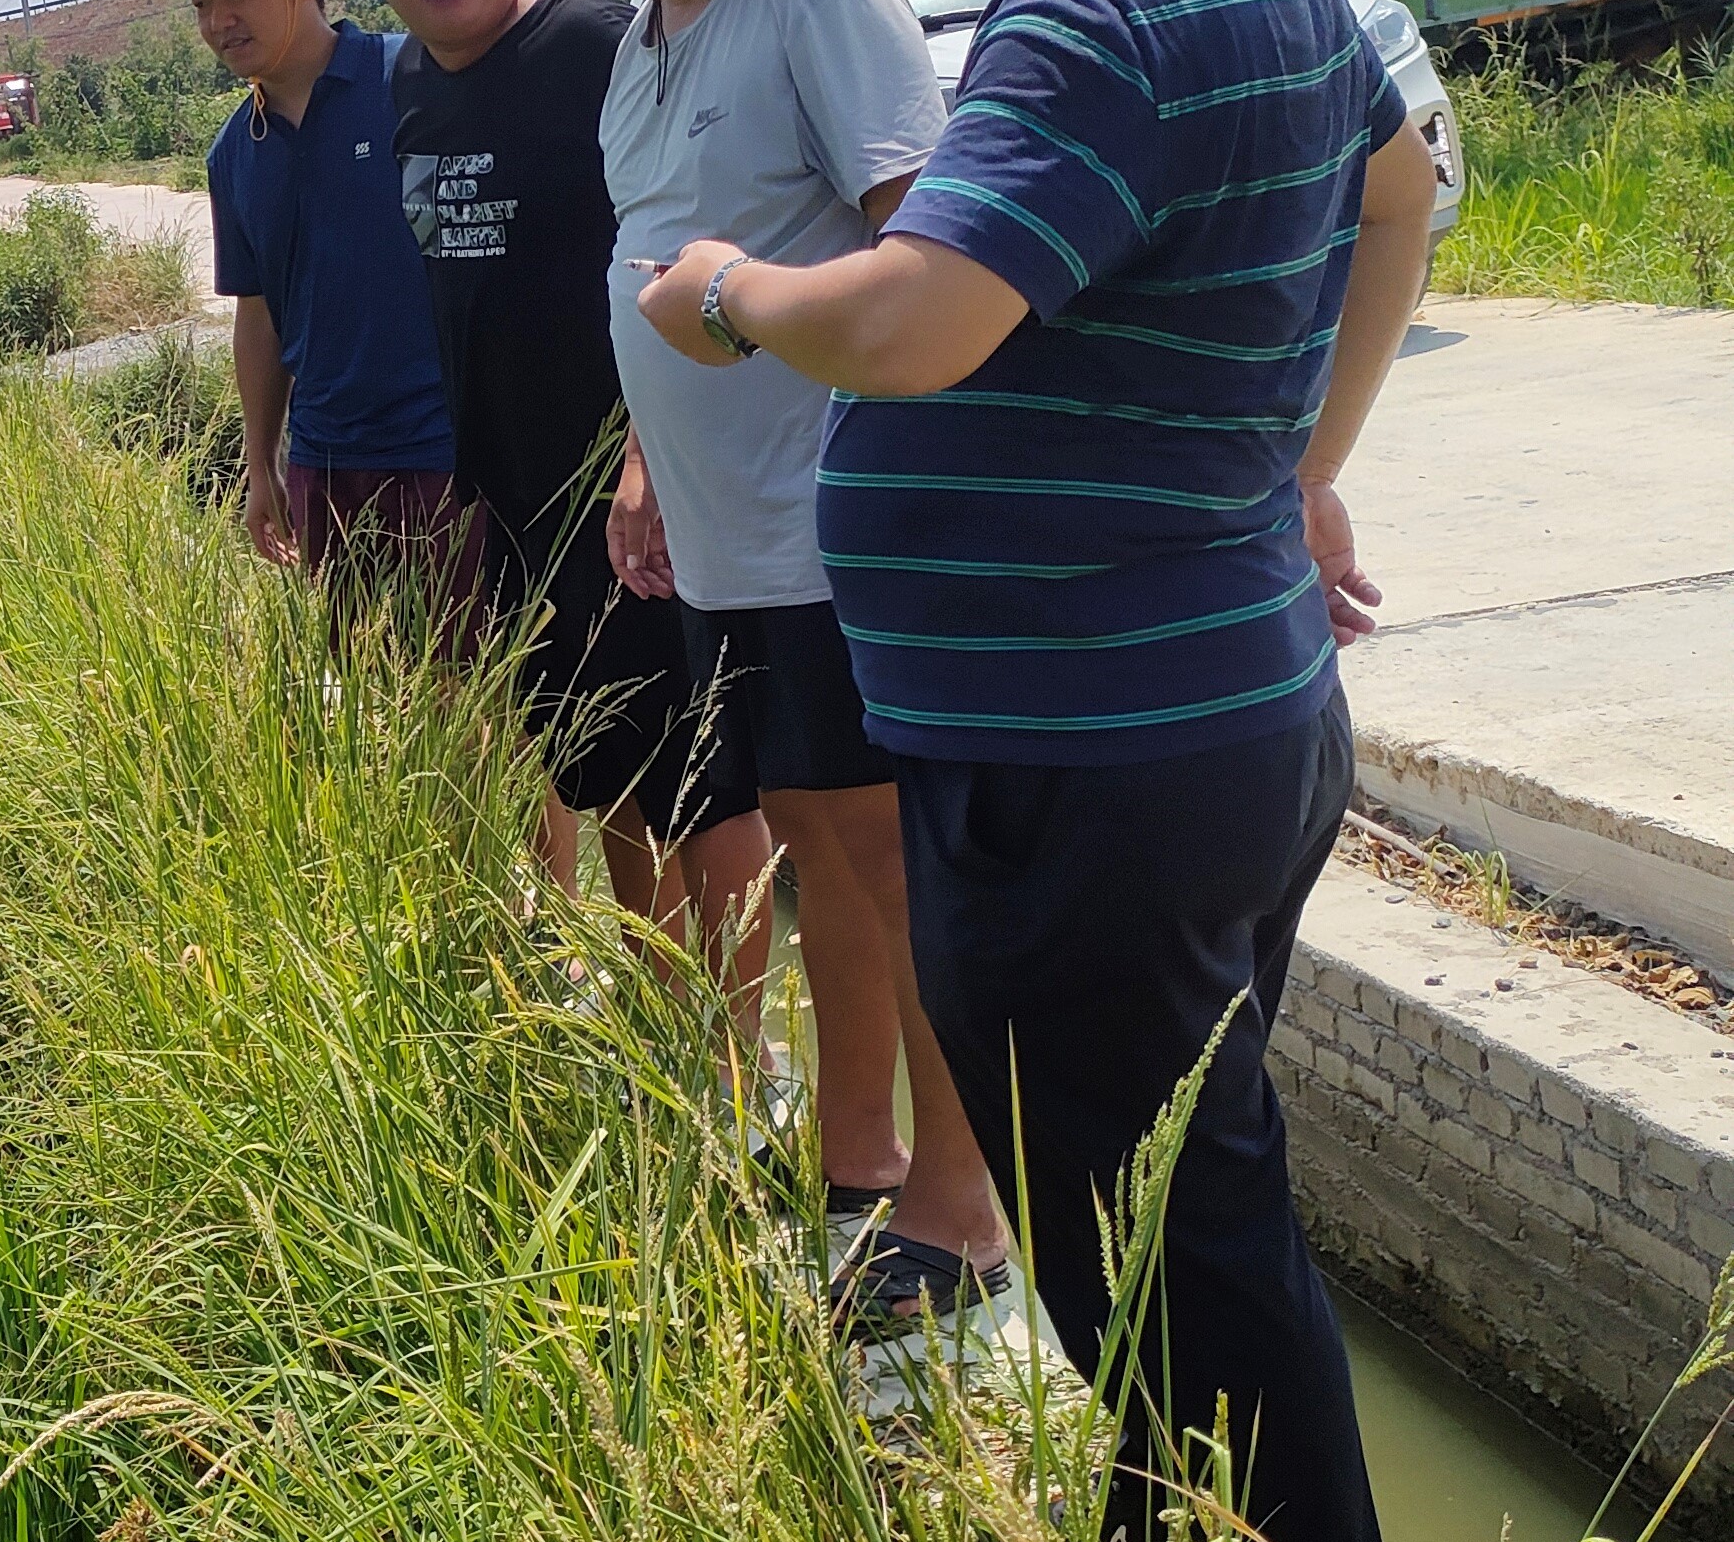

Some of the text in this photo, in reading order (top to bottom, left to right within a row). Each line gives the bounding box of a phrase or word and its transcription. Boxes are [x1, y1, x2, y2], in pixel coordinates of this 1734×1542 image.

[437, 179, 478, 200] AND
[437, 200, 519, 224] PLANET
[441, 225, 506, 247] EARTH
